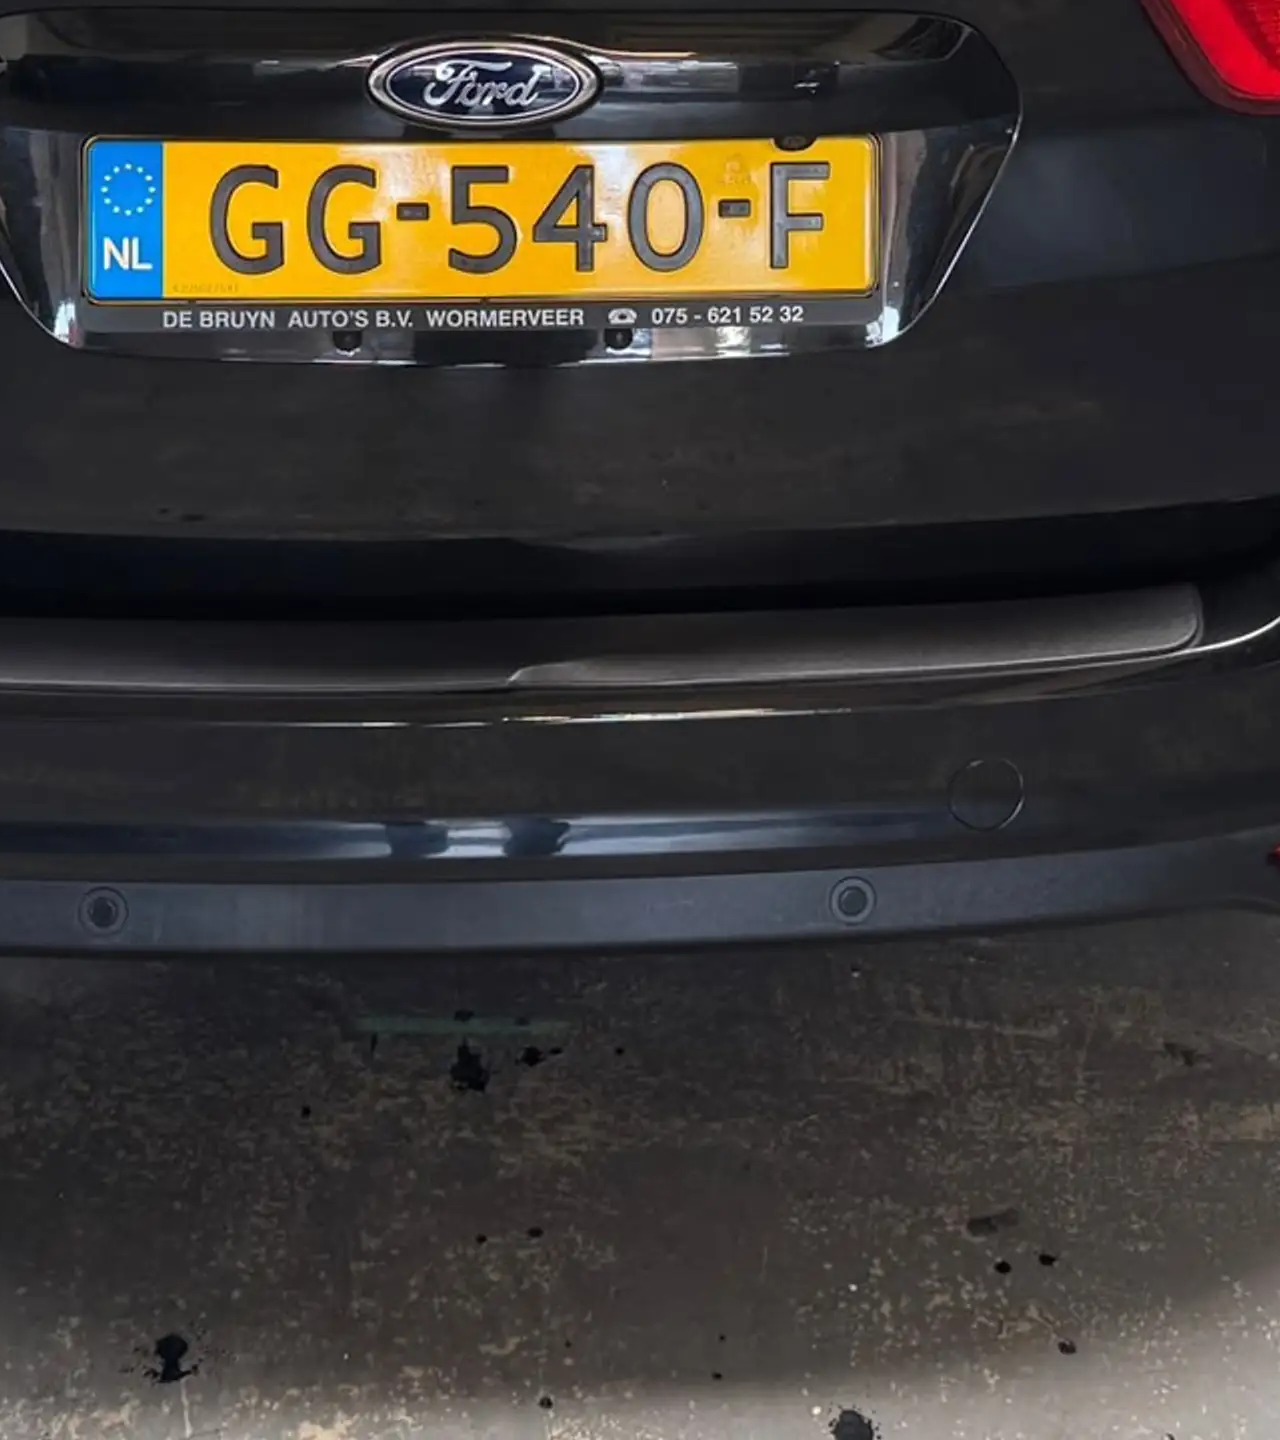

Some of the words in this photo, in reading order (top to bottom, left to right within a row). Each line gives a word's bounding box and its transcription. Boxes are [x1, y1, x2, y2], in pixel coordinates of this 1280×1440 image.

[423, 59, 553, 107] Ford
[208, 162, 831, 276] GG-540-F
[103, 236, 154, 271] NL
[163, 311, 192, 329] DE
[199, 311, 276, 329] BRUYN
[288, 310, 369, 328] AUTO'S
[376, 310, 414, 328] B.V.
[426, 308, 585, 328] WORMERVEER
[651, 307, 688, 325] 075
[707, 306, 741, 324] 621
[749, 306, 773, 323] 52
[779, 305, 804, 323] 32
